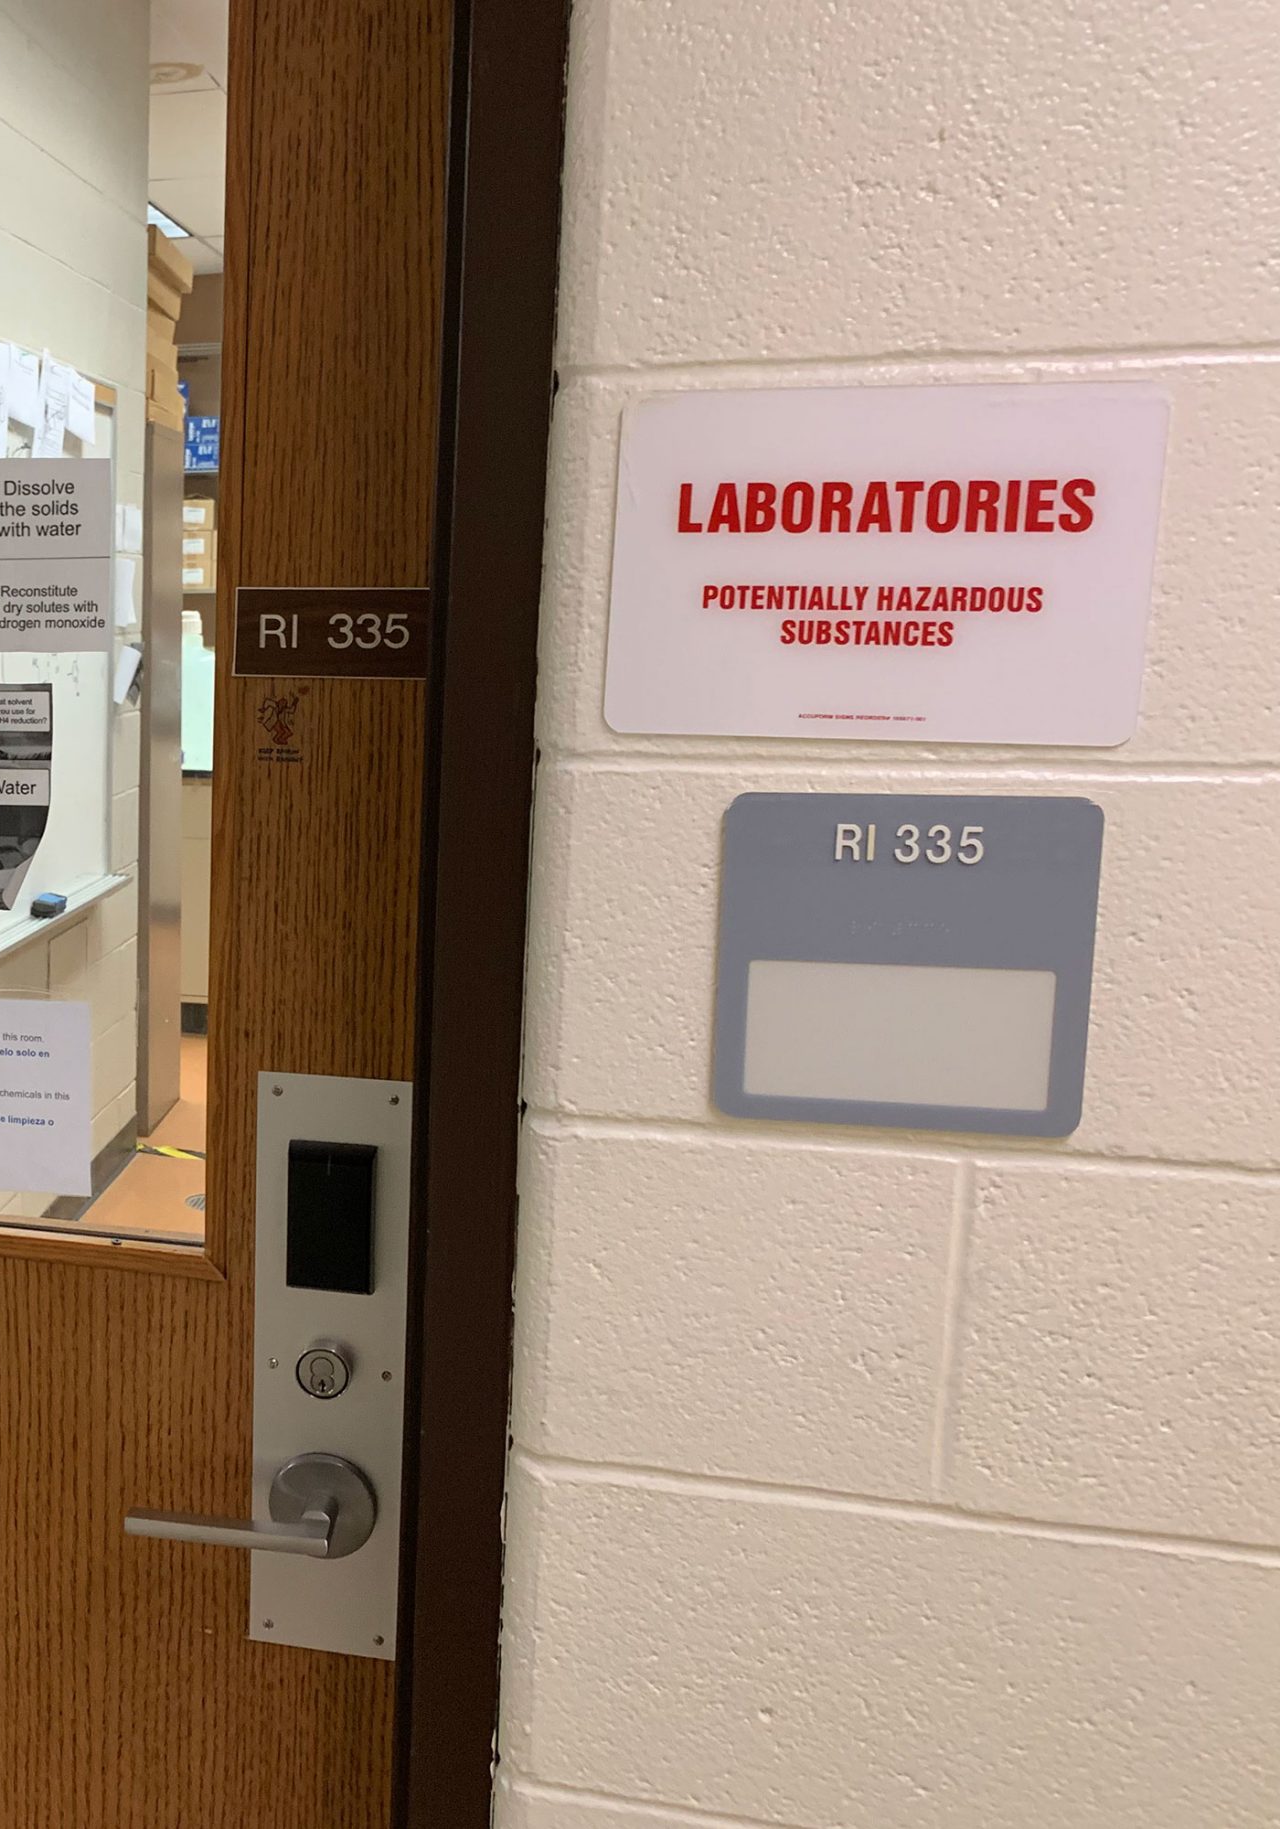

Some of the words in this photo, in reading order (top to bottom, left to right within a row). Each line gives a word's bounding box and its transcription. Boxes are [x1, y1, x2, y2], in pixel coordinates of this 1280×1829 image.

[4, 480, 75, 496] Dissolve
[0, 502, 26, 517] the
[31, 501, 79, 516] solids
[678, 479, 1095, 533] LABORATORIES
[36, 523, 82, 536] water
[0, 585, 78, 598] Reconstitute
[703, 585, 870, 611] POTENTIALLY
[877, 586, 1043, 613] HAZARDOUS
[3, 602, 23, 616] dry
[25, 601, 70, 613] solutes
[73, 601, 98, 613] with
[45, 616, 105, 628] monoxide
[259, 613, 298, 649] RI
[327, 613, 410, 649] 335
[780, 620, 954, 647] SUBSTANCES
[834, 823, 876, 861] RI
[894, 824, 985, 865] 335
[2, 1033, 18, 1041] this
[20, 1035, 44, 1043] room.
[16, 1048, 36, 1057] solo
[0, 1089, 42, 1099] chemicals
[44, 1091, 52, 1099] in
[54, 1092, 70, 1100] this
[7, 1115, 45, 1126] limpieza
